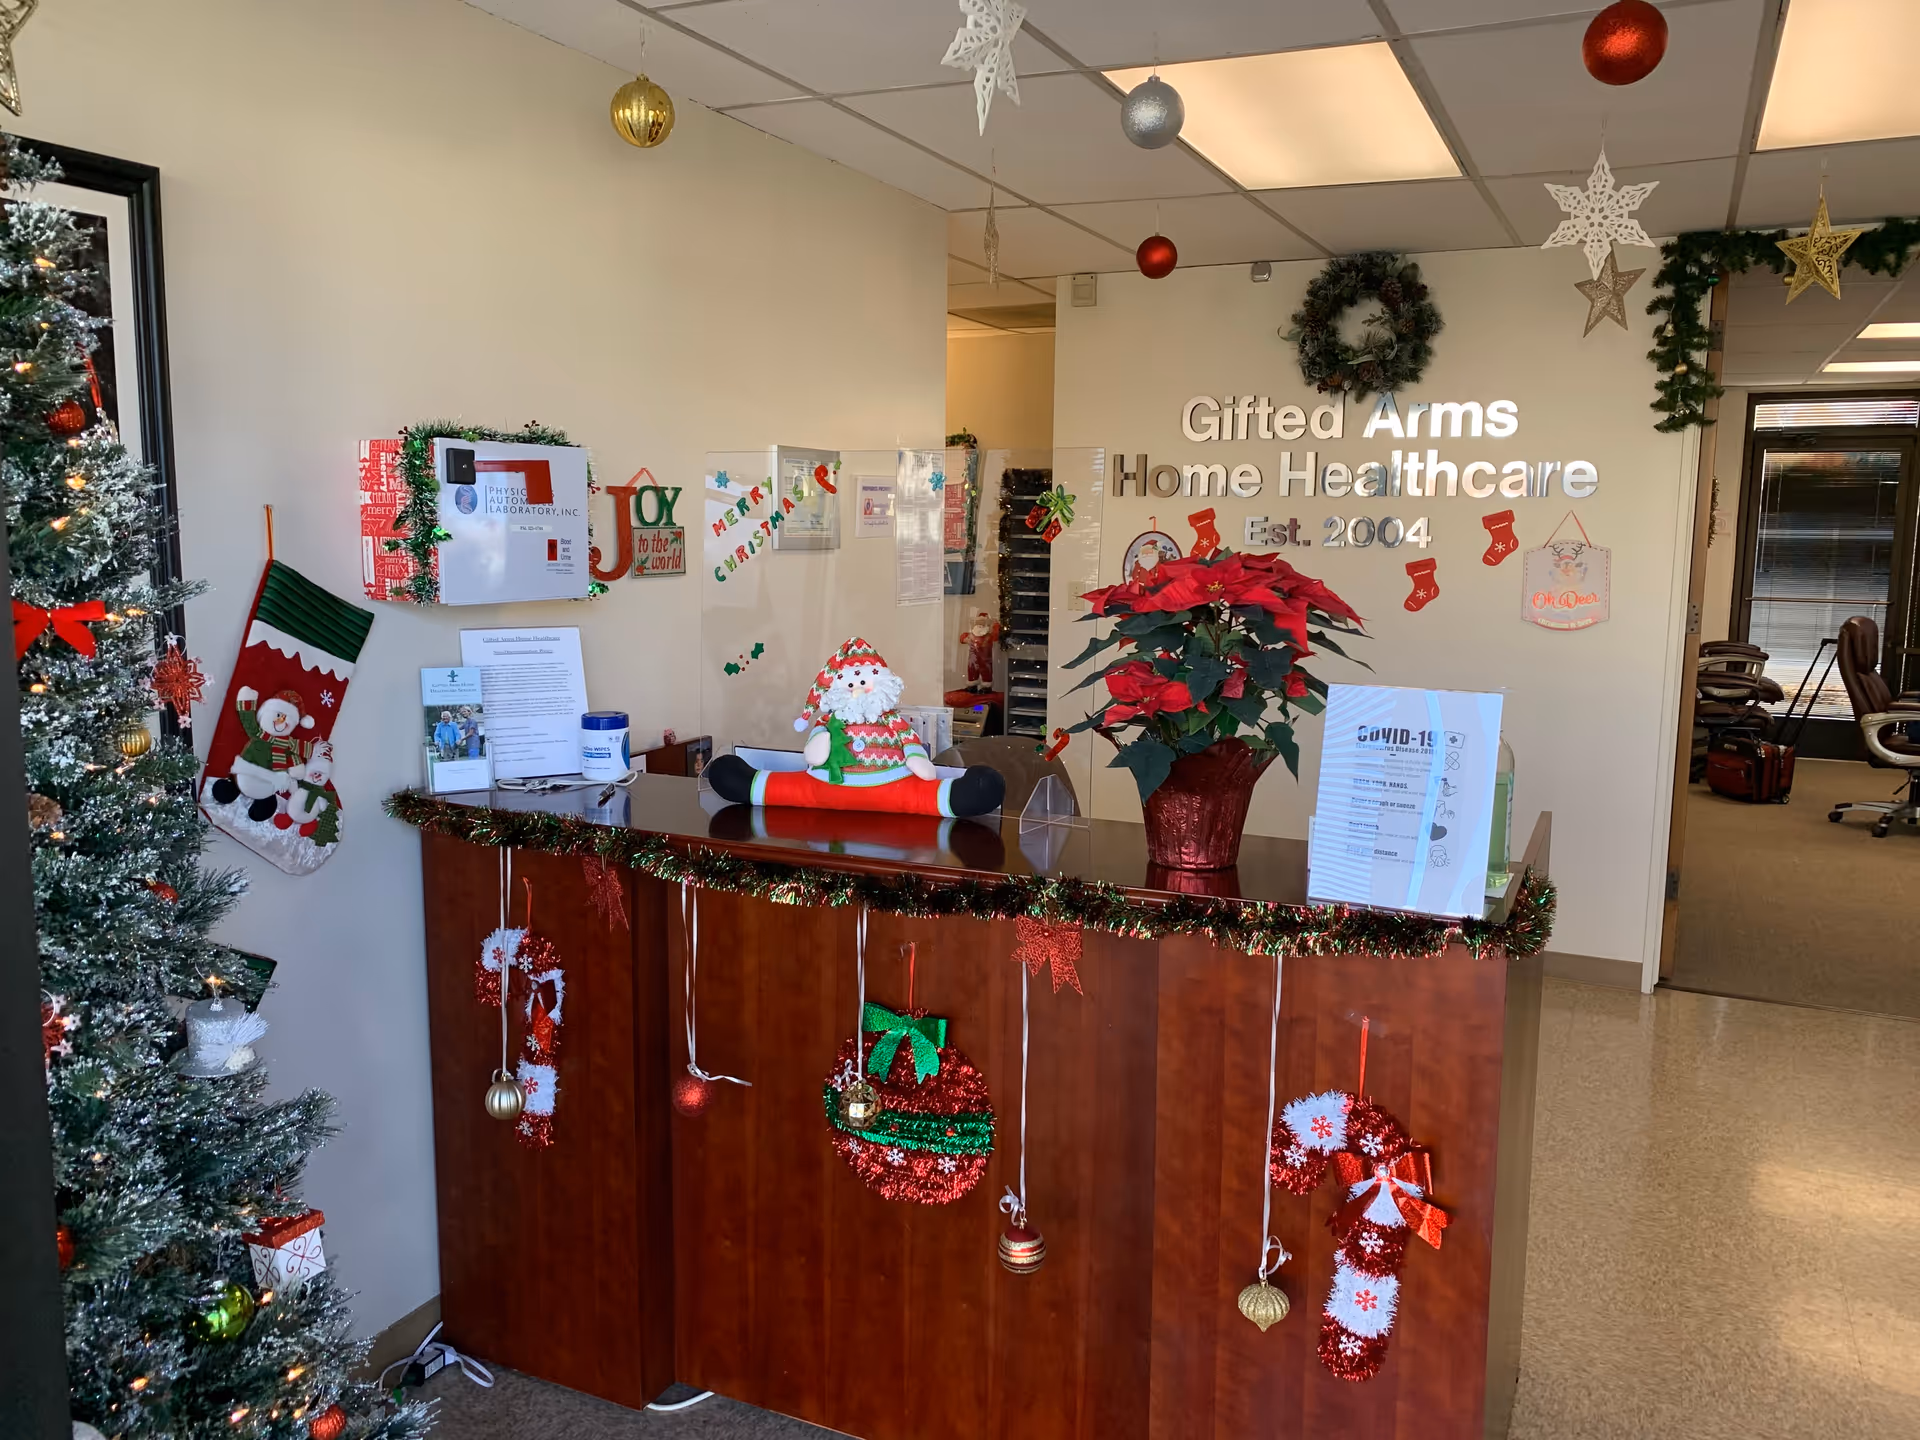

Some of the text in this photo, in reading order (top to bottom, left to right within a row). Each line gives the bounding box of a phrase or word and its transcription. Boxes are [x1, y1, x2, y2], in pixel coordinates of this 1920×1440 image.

[1181, 391, 1519, 442] Gifted Arms
[1112, 449, 1600, 499] Home Healthcare
[489, 486, 555, 498] PHYSIC
[489, 496, 554, 507] AUTOM
[489, 505, 581, 517] LABORATORY, INC.
[712, 477, 773, 537] MERRY
[588, 485, 683, 581] JOY
[638, 530, 669, 553] to the
[714, 484, 804, 582] CHRISTMAS
[1244, 516, 1433, 548] Est. 2004
[651, 548, 682, 570] world
[1532, 590, 1600, 609] Oh Deer
[1357, 725, 1438, 747] COVID-19
[1396, 745, 1419, 754] Disease
[1374, 848, 1398, 857] distance
